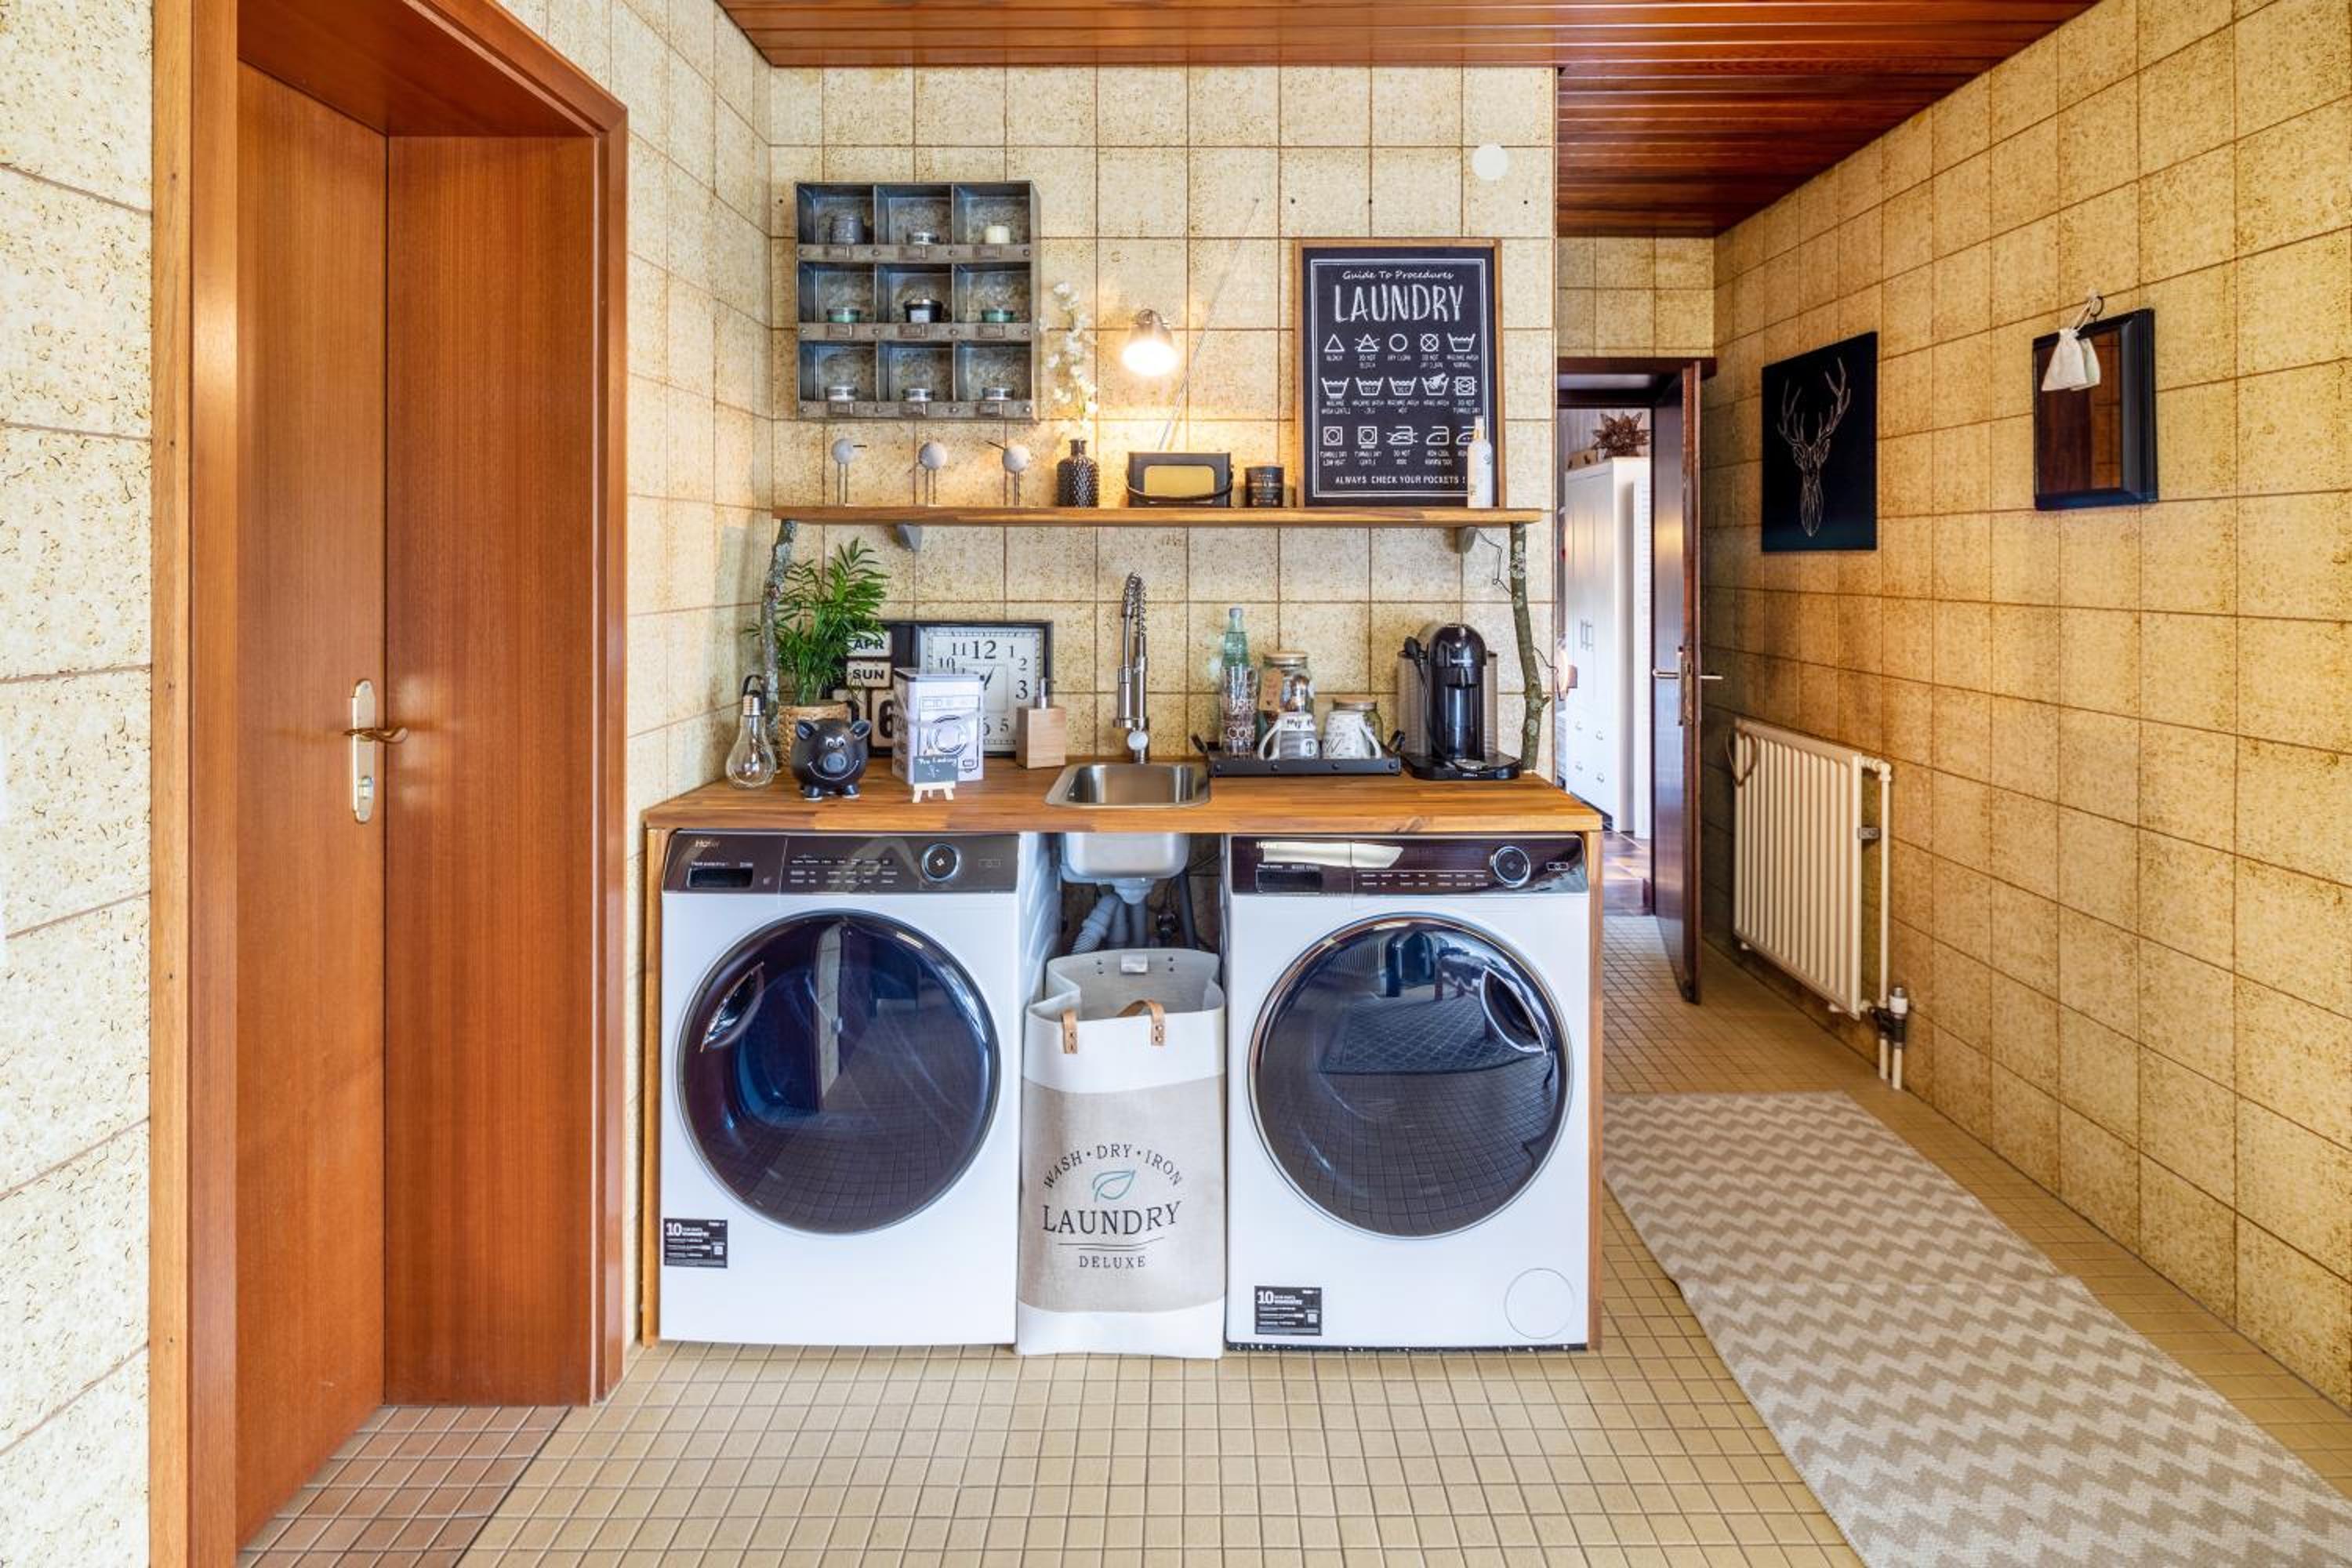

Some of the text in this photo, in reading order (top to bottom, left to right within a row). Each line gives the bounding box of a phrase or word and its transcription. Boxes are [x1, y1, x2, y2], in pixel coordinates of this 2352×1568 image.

[1341, 270, 1455, 280] Guide To Procedures
[1334, 283, 1464, 323] LAUNDRY
[1335, 476, 1367, 485] ALWAYS
[1371, 475, 1396, 484] CHECK
[1399, 475, 1421, 484] YOUR
[1423, 475, 1459, 484] POCKETS
[971, 640, 996, 659] 12
[1009, 645, 1014, 658] 1
[1018, 659, 1028, 671] 2
[852, 669, 884, 680] SUN
[1016, 680, 1028, 700] 3
[1000, 717, 1009, 732] 5
[1044, 1144, 1183, 1189] WASH DRY IRON
[1042, 1200, 1182, 1236] LAUNDRY
[666, 1221, 683, 1236] 10
[1079, 1255, 1146, 1269] DELUXE
[1257, 1290, 1274, 1305] 10
